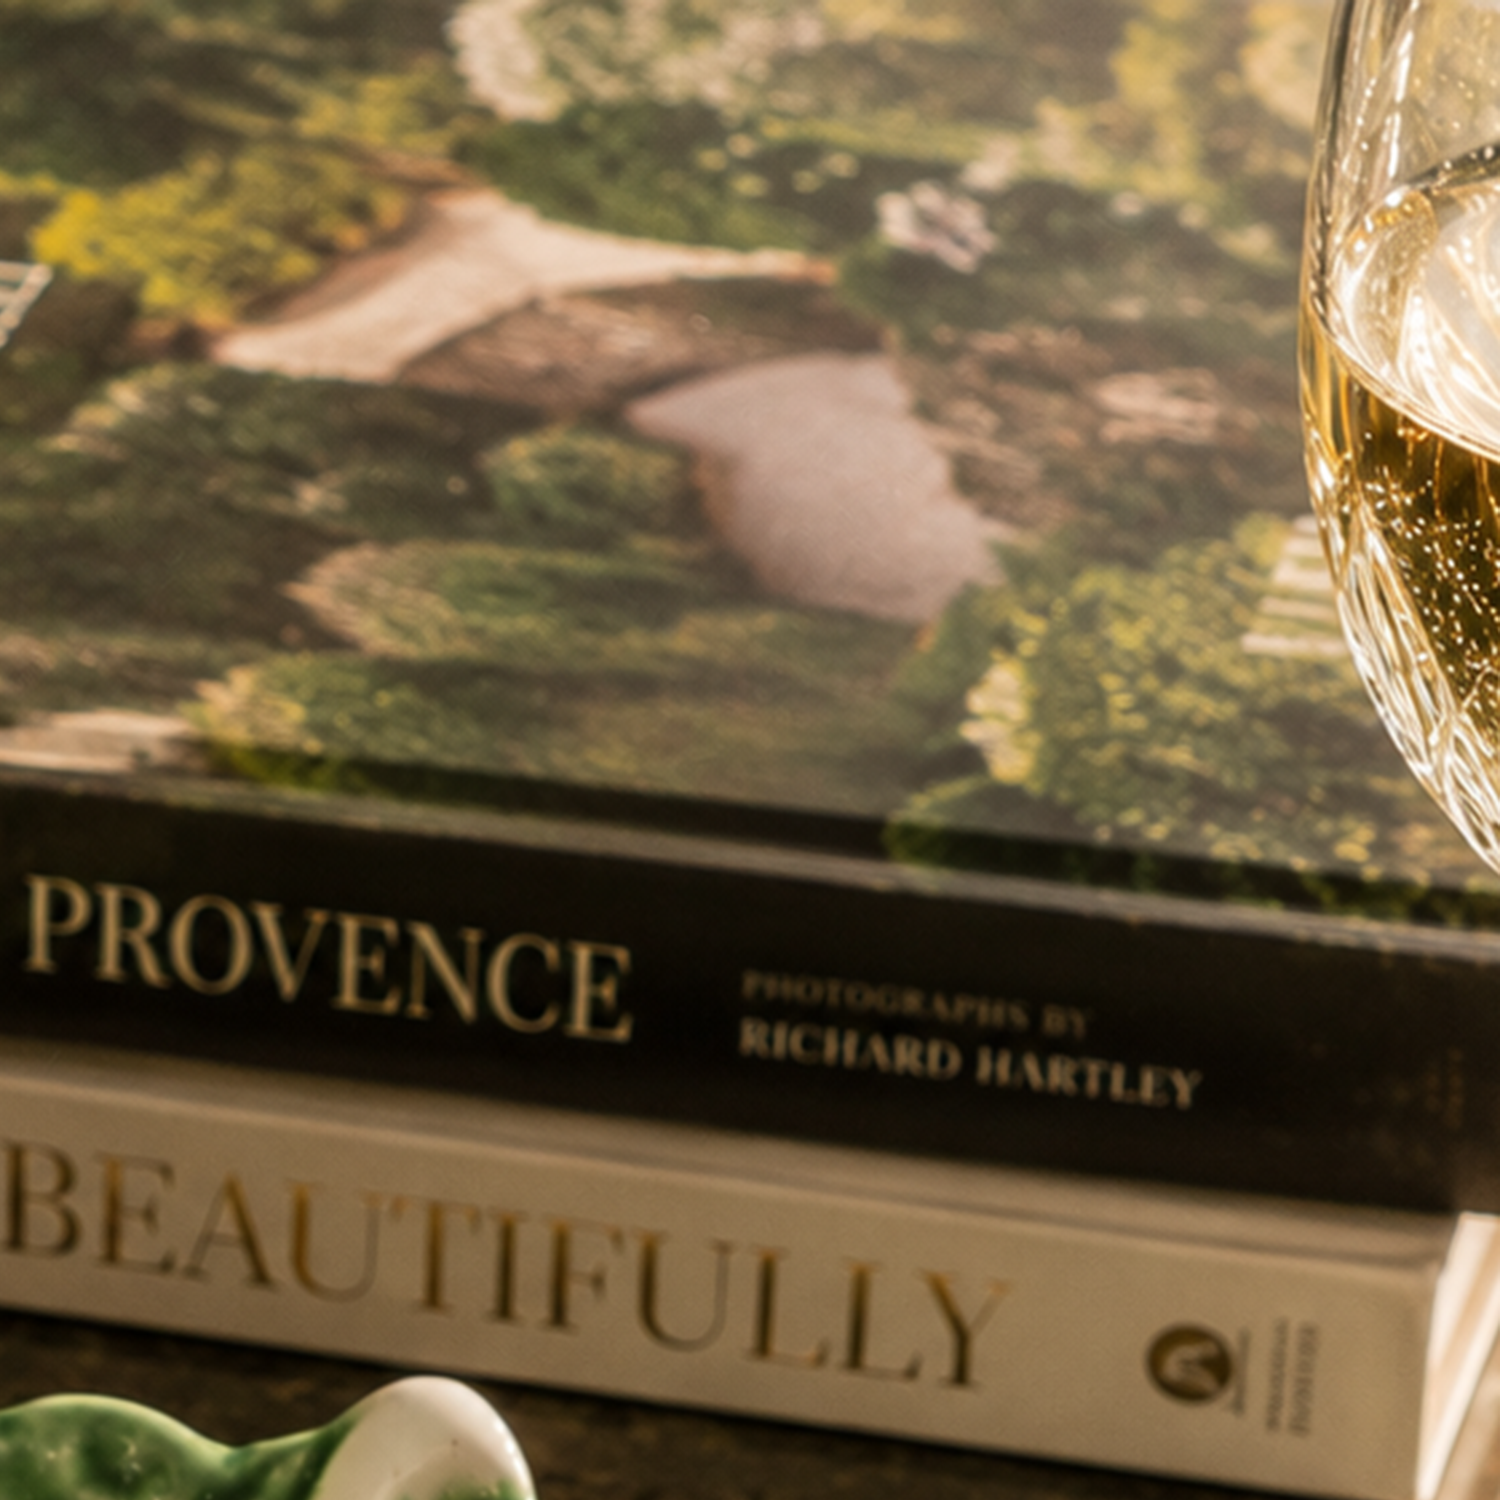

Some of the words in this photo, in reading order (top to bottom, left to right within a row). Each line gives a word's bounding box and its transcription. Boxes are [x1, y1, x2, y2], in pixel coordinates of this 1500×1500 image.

[25, 876, 631, 1042] PROVENCE
[742, 970, 1032, 1030] PHOTOGRAPHS
[1044, 1005, 1092, 1040] BY
[739, 1018, 961, 1080] RICHARD
[976, 1048, 1202, 1109] HARTLEY
[2, 1139, 1010, 1387] BEAUTIFULLY
